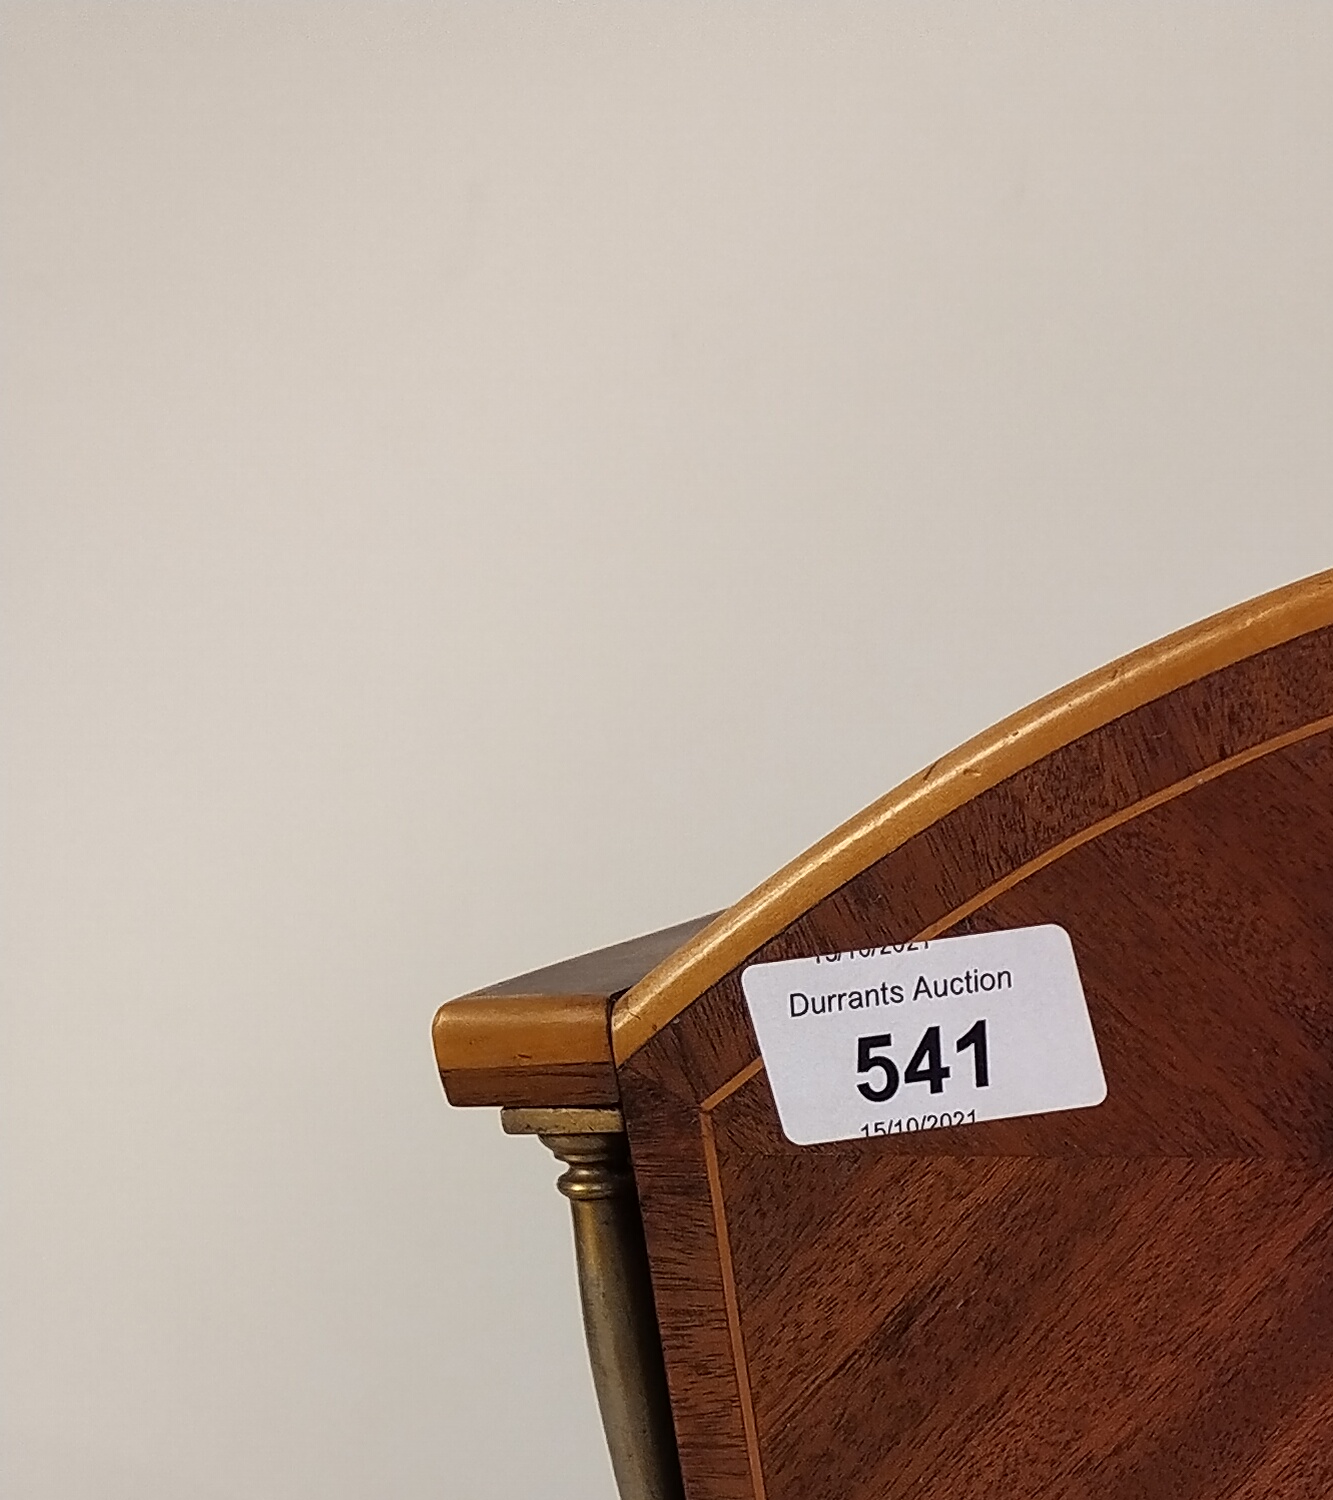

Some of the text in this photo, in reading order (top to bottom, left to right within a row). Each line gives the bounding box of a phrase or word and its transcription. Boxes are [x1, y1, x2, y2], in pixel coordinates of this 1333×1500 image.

[789, 969, 1012, 1018] Durrants Auction
[856, 1020, 989, 1102] 541
[860, 1109, 976, 1137] 15/10/2021
